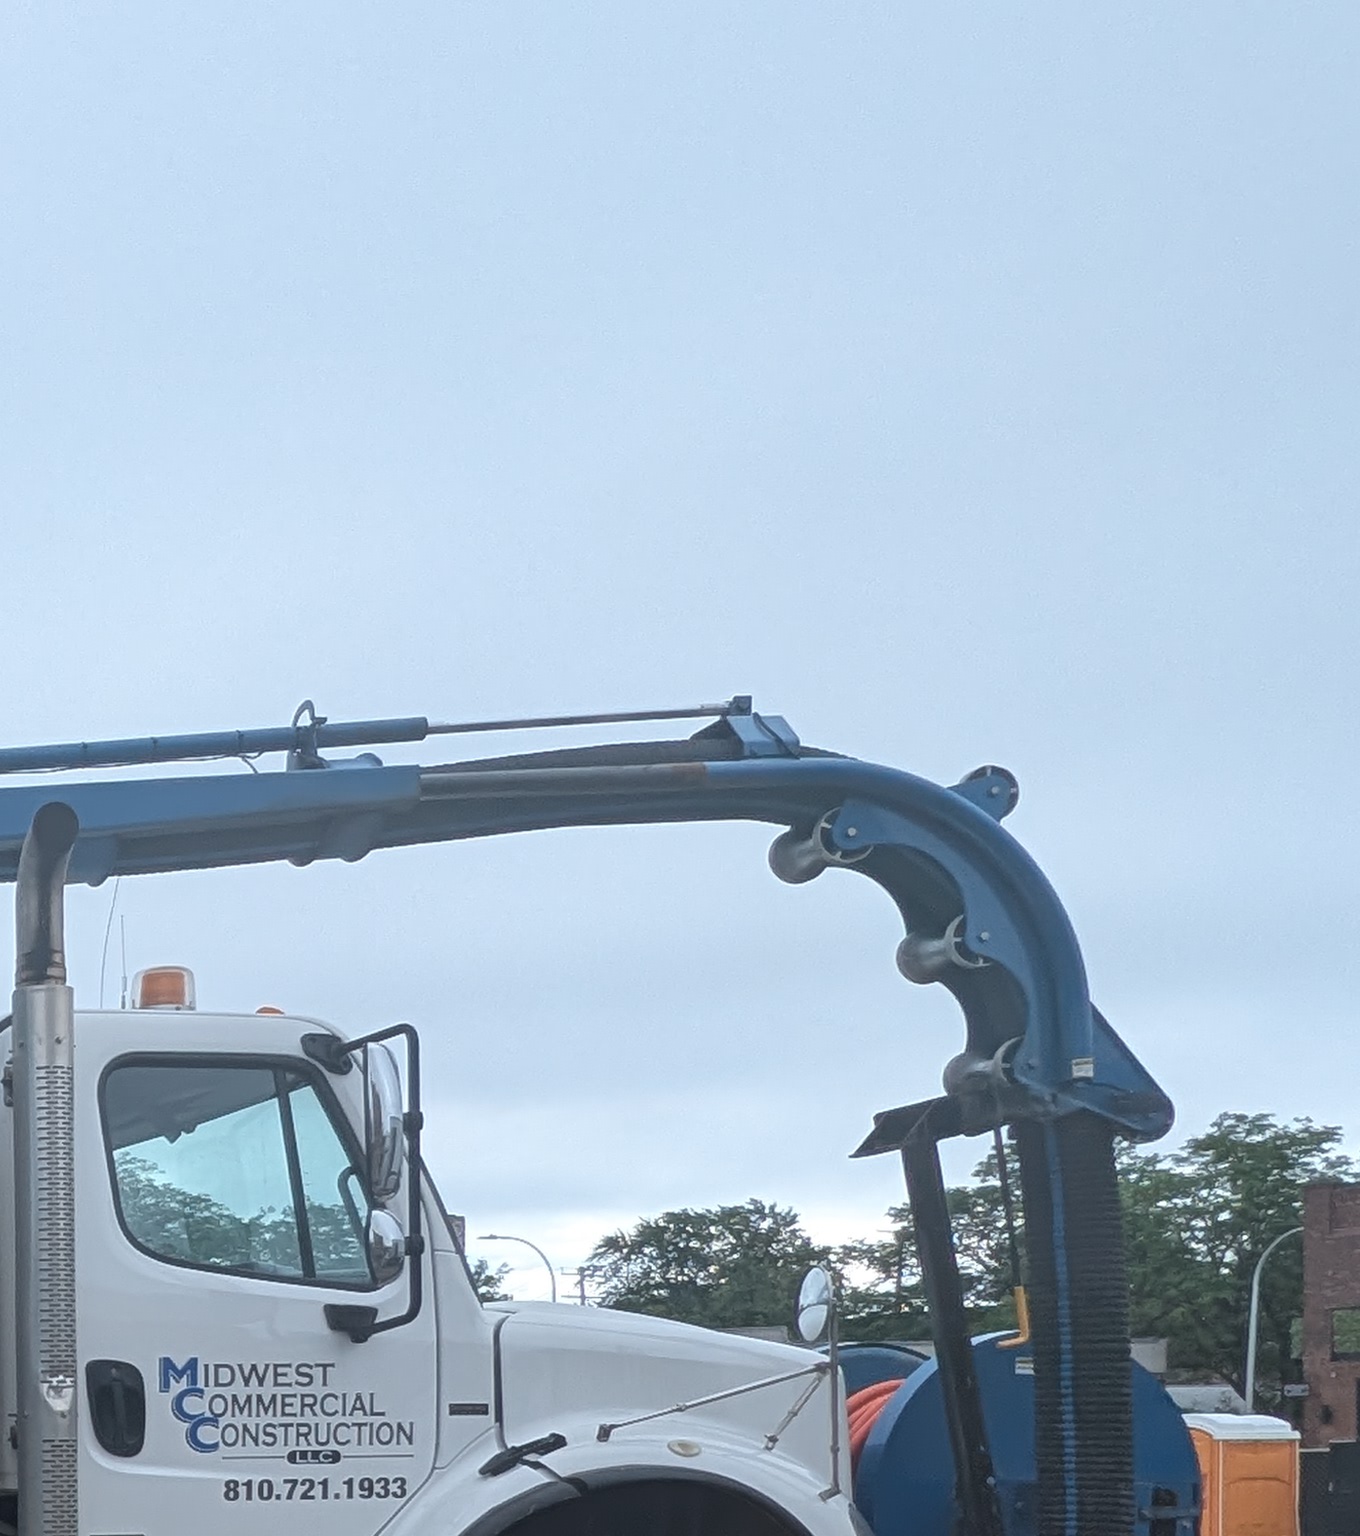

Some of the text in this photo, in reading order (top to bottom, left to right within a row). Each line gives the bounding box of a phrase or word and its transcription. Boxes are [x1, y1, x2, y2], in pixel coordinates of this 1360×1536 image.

[158, 1356, 335, 1393] MIDWEST
[171, 1387, 385, 1424] COMMERCIAL
[185, 1416, 414, 1453] CONSTRUCTION
[294, 1450, 333, 1464] LLC
[223, 1477, 408, 1502] 810.721.1933
